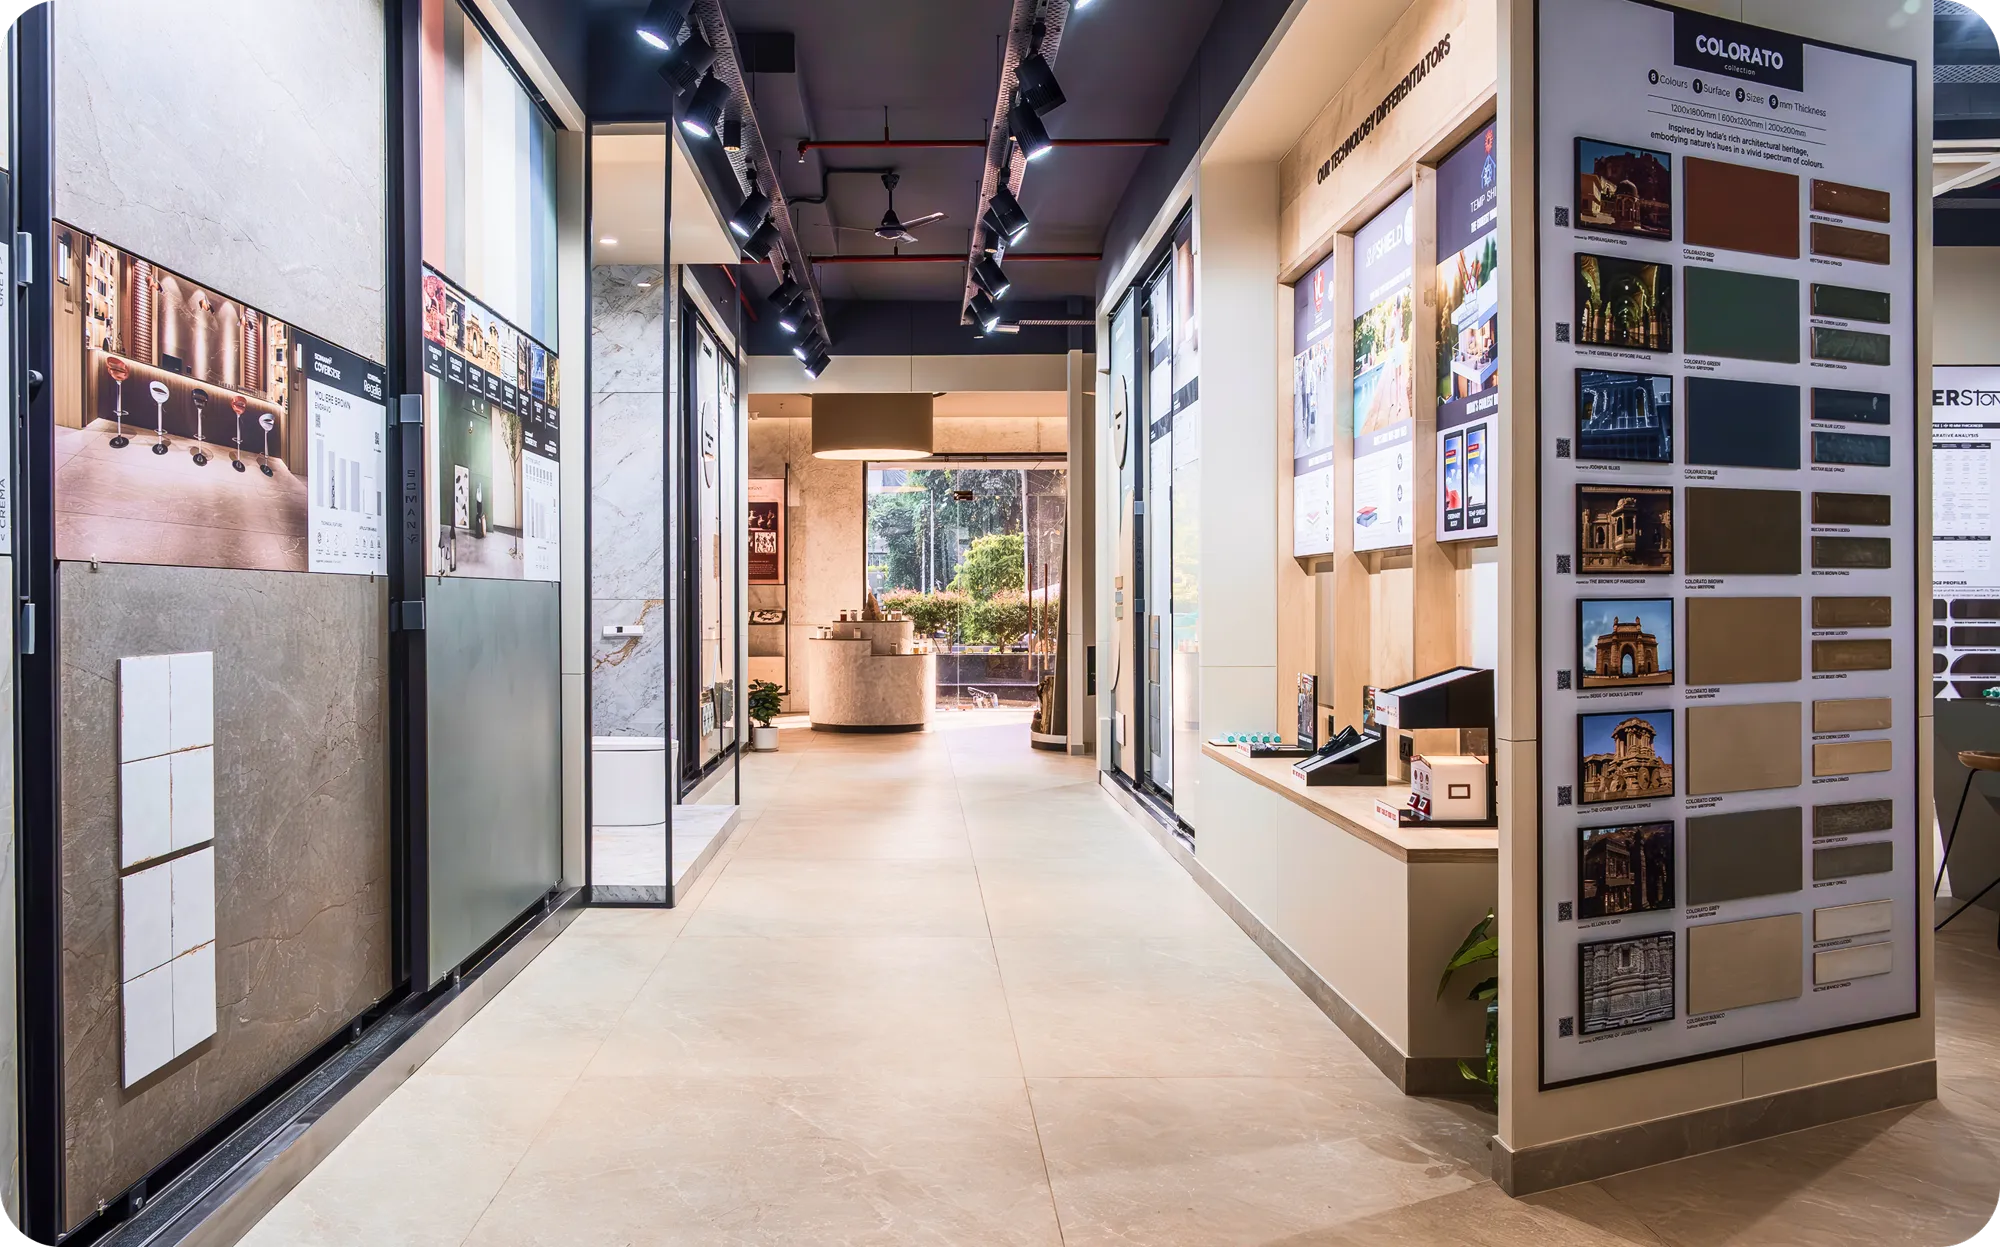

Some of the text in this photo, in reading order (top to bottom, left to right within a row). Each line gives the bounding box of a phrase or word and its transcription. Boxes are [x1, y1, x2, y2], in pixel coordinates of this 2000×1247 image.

[1696, 34, 1783, 69] COLORATO
[1724, 64, 1756, 76] collection
[1316, 33, 1450, 186] OUR TECHNOLOGY DIFFERENTIATORS
[1660, 74, 1688, 88] Colours
[1704, 84, 1730, 97] Surface
[1746, 92, 1764, 104] Sizes
[1779, 101, 1793, 110] mm
[1794, 102, 1826, 117] Thickness
[1671, 104, 1806, 137] 1200x1800mm 600x1200mm 200x200mm
[1650, 131, 1688, 146] embodying
[1690, 138, 1716, 150] nature's
[1717, 143, 1732, 152] hues
[1734, 145, 1740, 154] in
[1747, 148, 1761, 158] vivid
[1763, 151, 1792, 164] spectrum
[1800, 159, 1824, 169] colours.
[1668, 123, 1808, 157] Inspired by India's rich architectural heritage,
[1470, 194, 1486, 213] TEMP
[335, 397, 351, 410] BROWN
[405, 469, 418, 544] SOMANY
